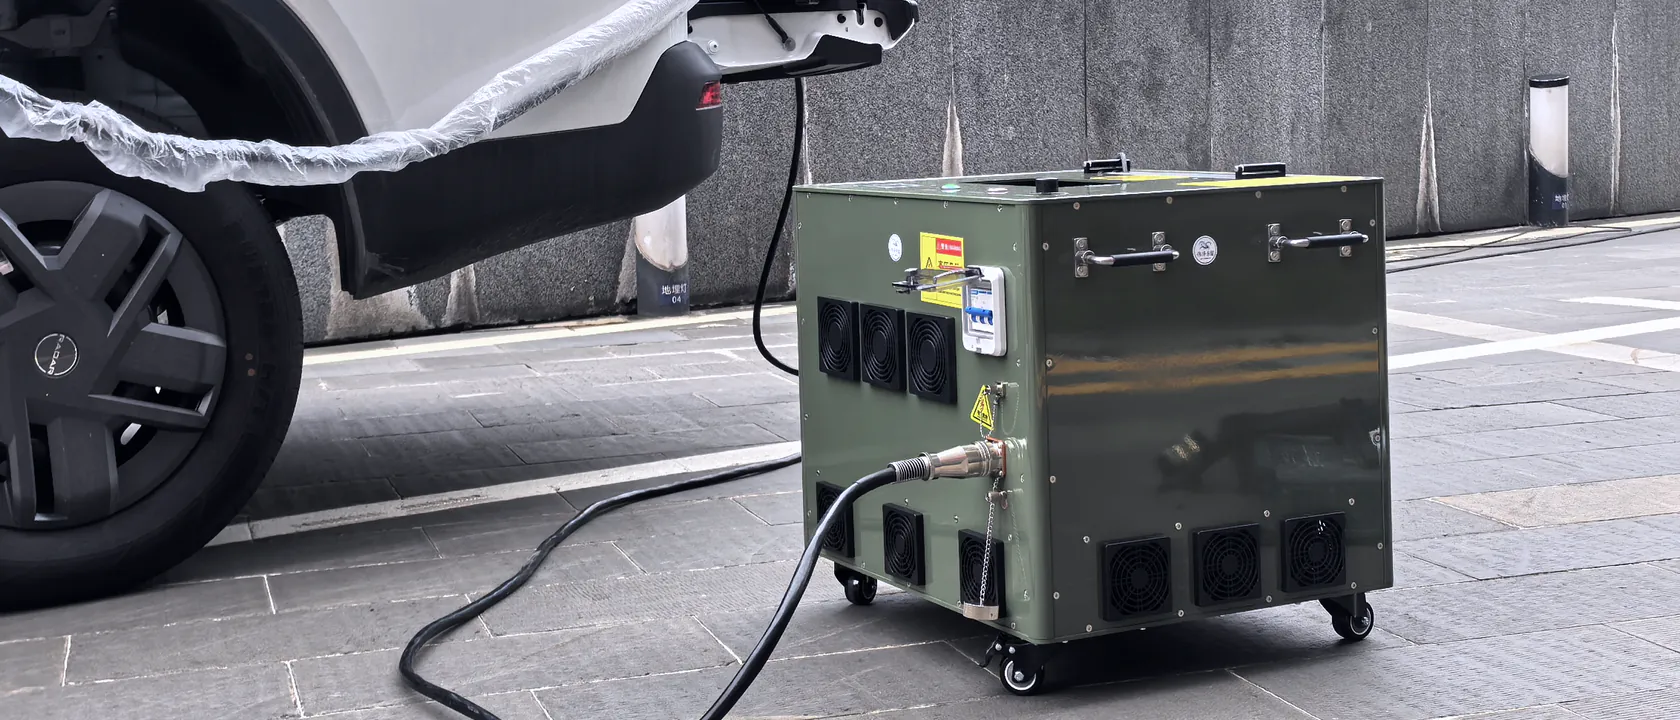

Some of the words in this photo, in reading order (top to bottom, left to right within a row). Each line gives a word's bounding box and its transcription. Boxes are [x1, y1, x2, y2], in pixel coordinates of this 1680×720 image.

[661, 283, 687, 295] 地埋灯
[671, 295, 682, 304] 04
[47, 333, 66, 375] RADAR
